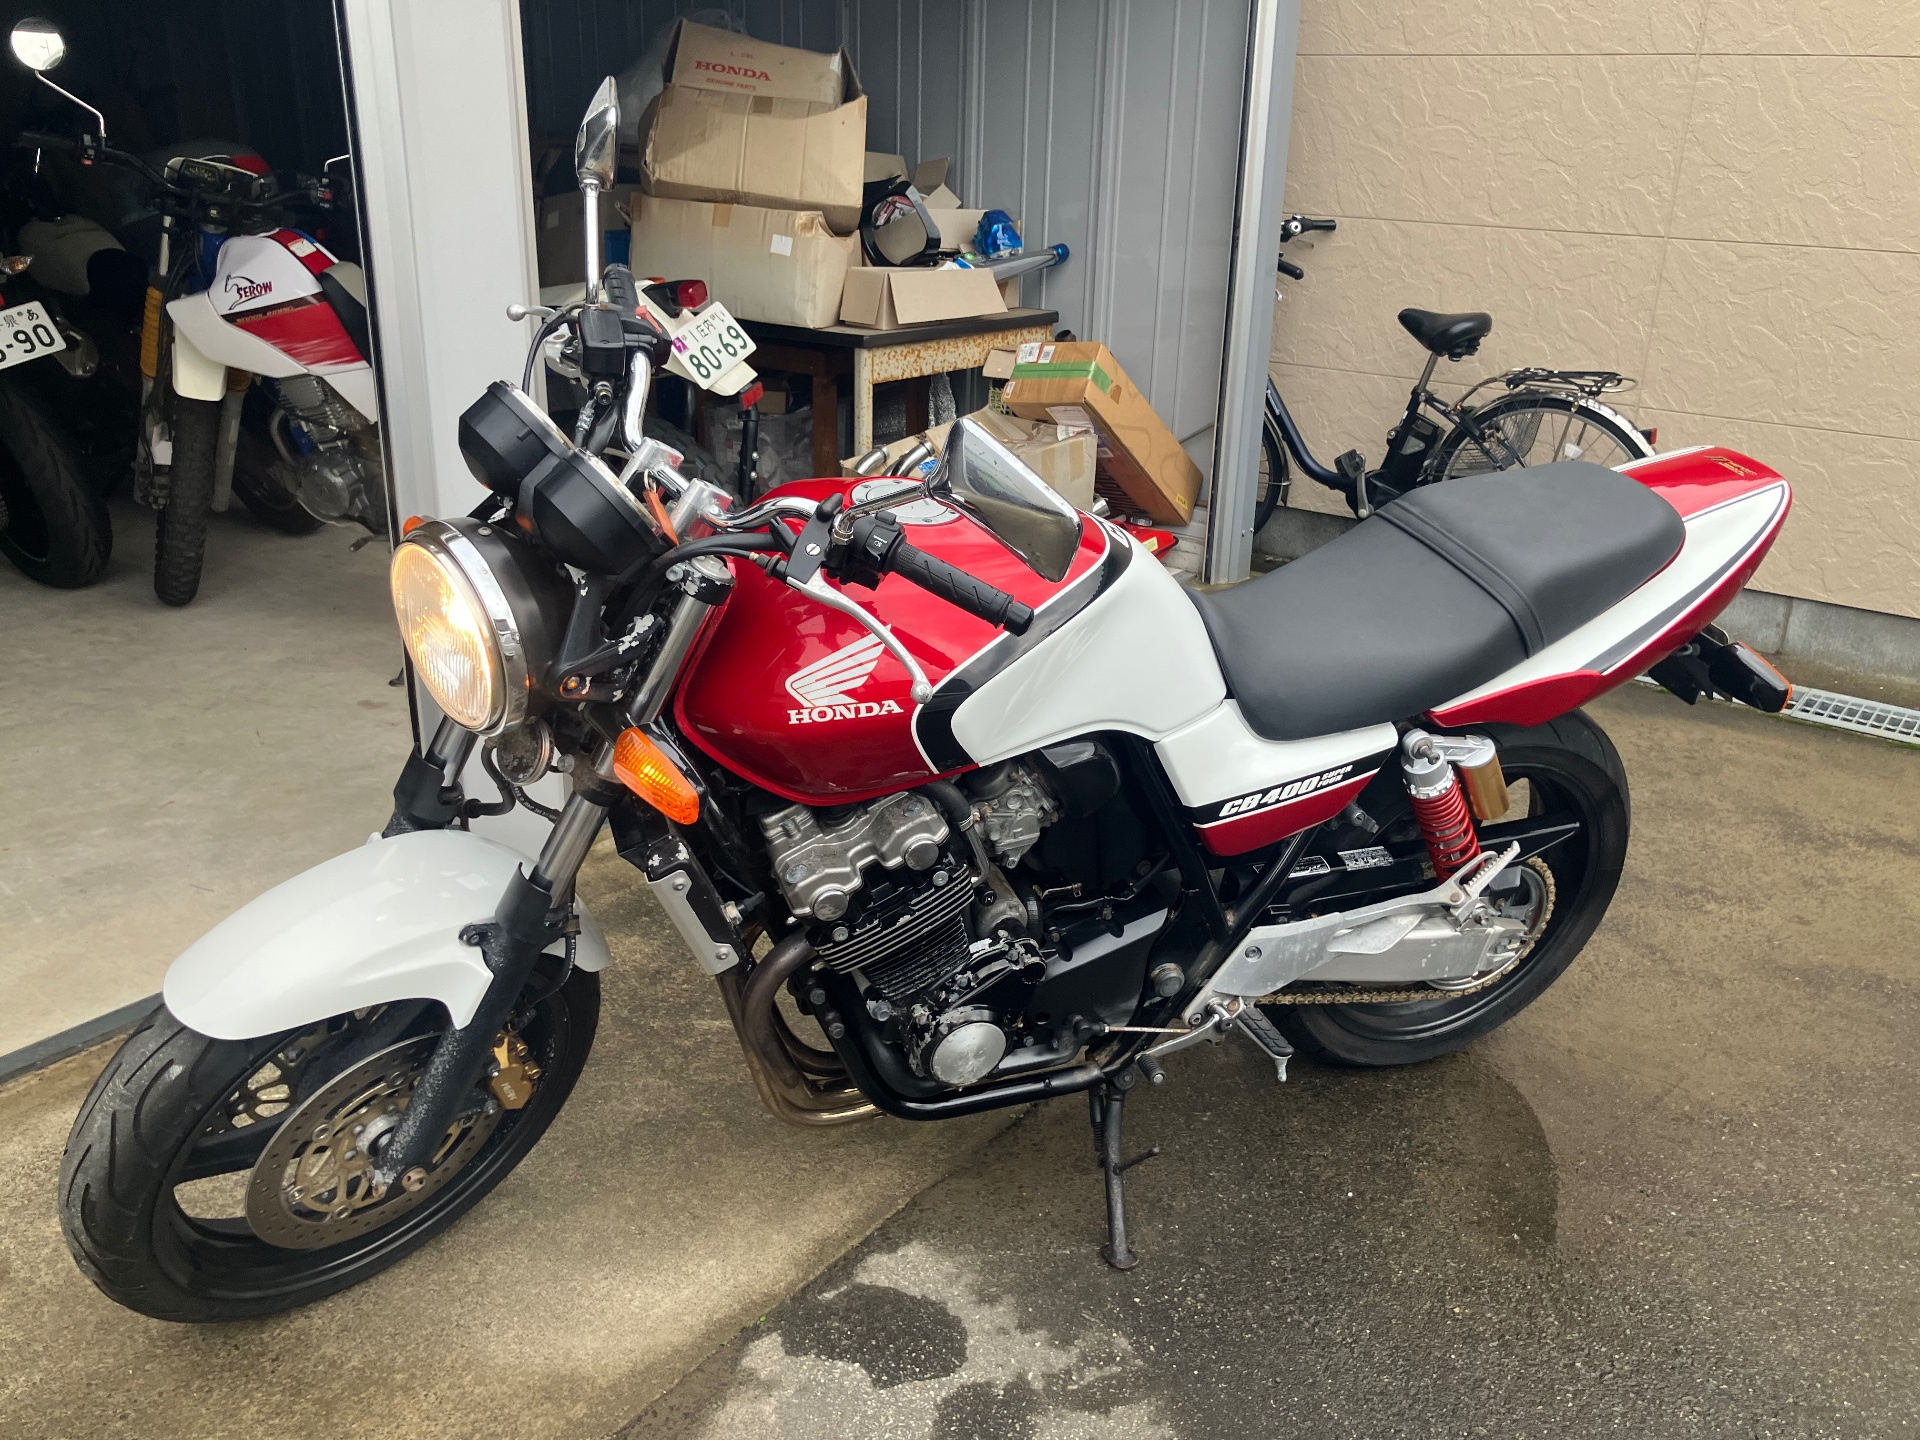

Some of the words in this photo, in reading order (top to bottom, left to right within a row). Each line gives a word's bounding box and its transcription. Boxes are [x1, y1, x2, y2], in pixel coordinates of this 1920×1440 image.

[695, 60, 771, 81] HONDA
[237, 281, 273, 300] SEROW
[690, 326, 747, 378] 80-69
[787, 700, 904, 724] HONDA
[1316, 774, 1343, 788] FOUR
[1321, 764, 1353, 781] SUPER
[1219, 776, 1320, 816] CB400
